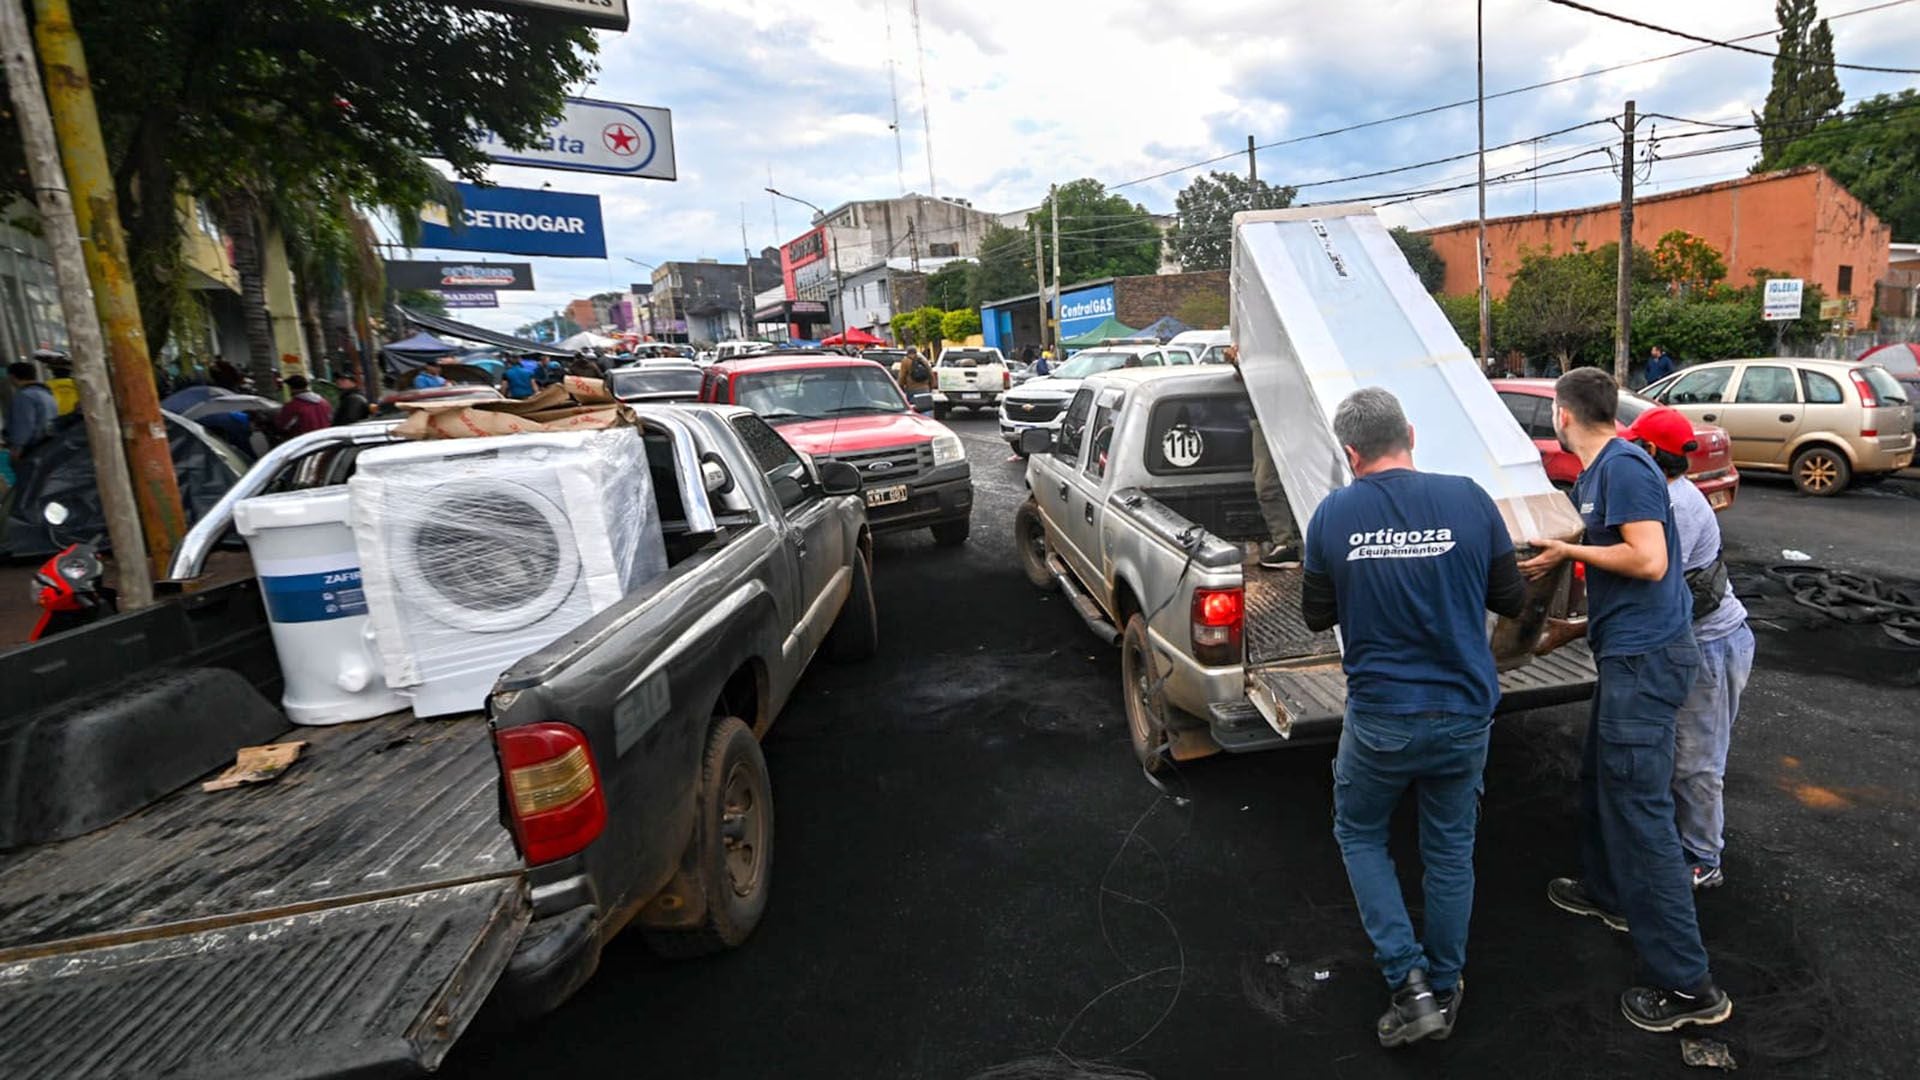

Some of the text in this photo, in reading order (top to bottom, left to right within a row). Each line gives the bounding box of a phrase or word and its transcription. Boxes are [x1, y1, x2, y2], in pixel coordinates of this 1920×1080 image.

[539, 134, 585, 154] ata
[458, 209, 585, 234] CETROGAR
[1061, 297, 1113, 318] CentralGAS
[1165, 430, 1202, 459] 110
[1348, 528, 1452, 548] ortigoza
[1358, 544, 1446, 558] Equipamientos
